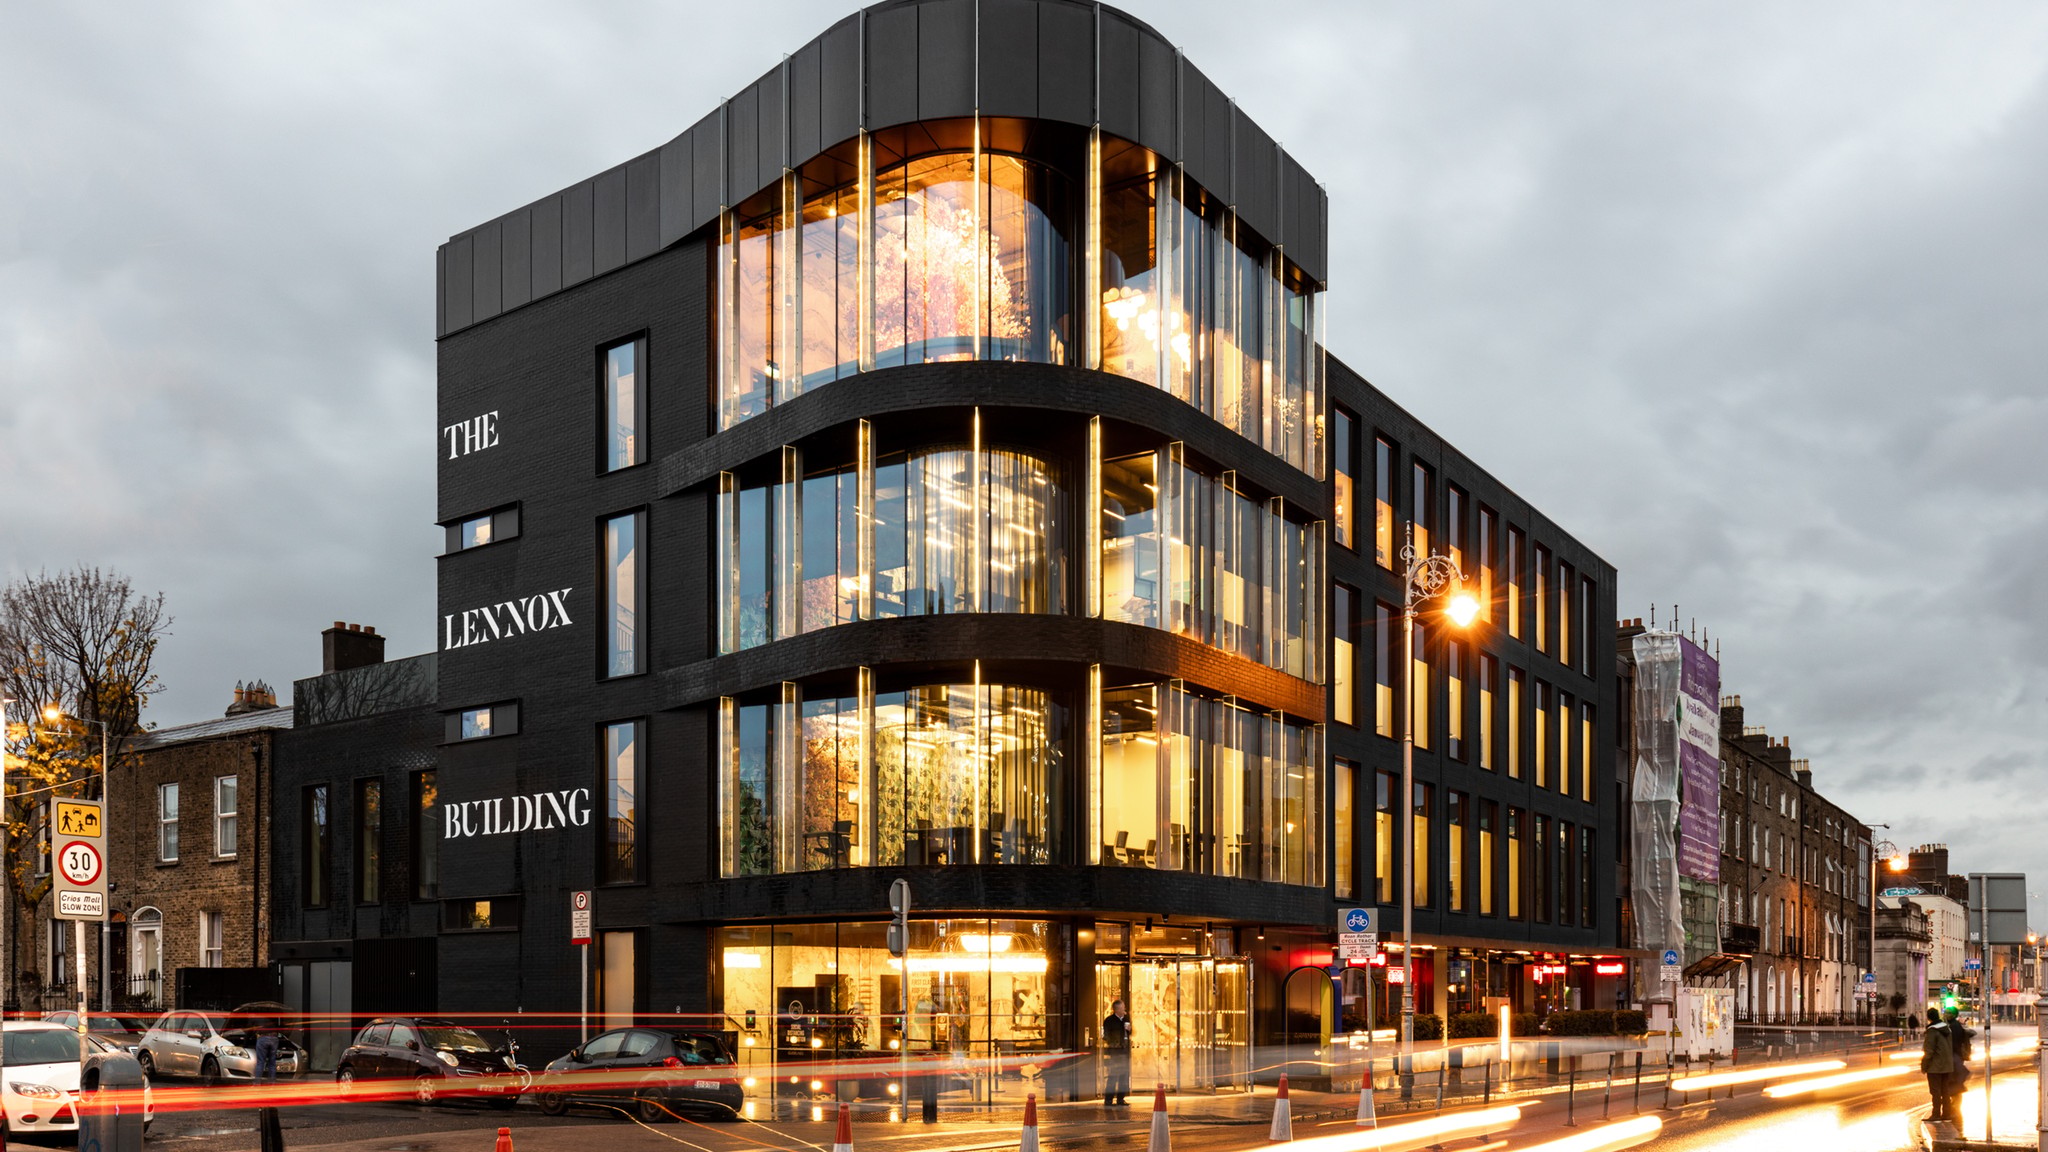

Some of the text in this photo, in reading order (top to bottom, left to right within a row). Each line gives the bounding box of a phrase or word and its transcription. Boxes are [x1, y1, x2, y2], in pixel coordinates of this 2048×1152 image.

[444, 410, 499, 460] THE
[444, 587, 573, 650] LENNOX
[444, 788, 591, 839] BUILDING
[70, 852, 90, 870] 30
